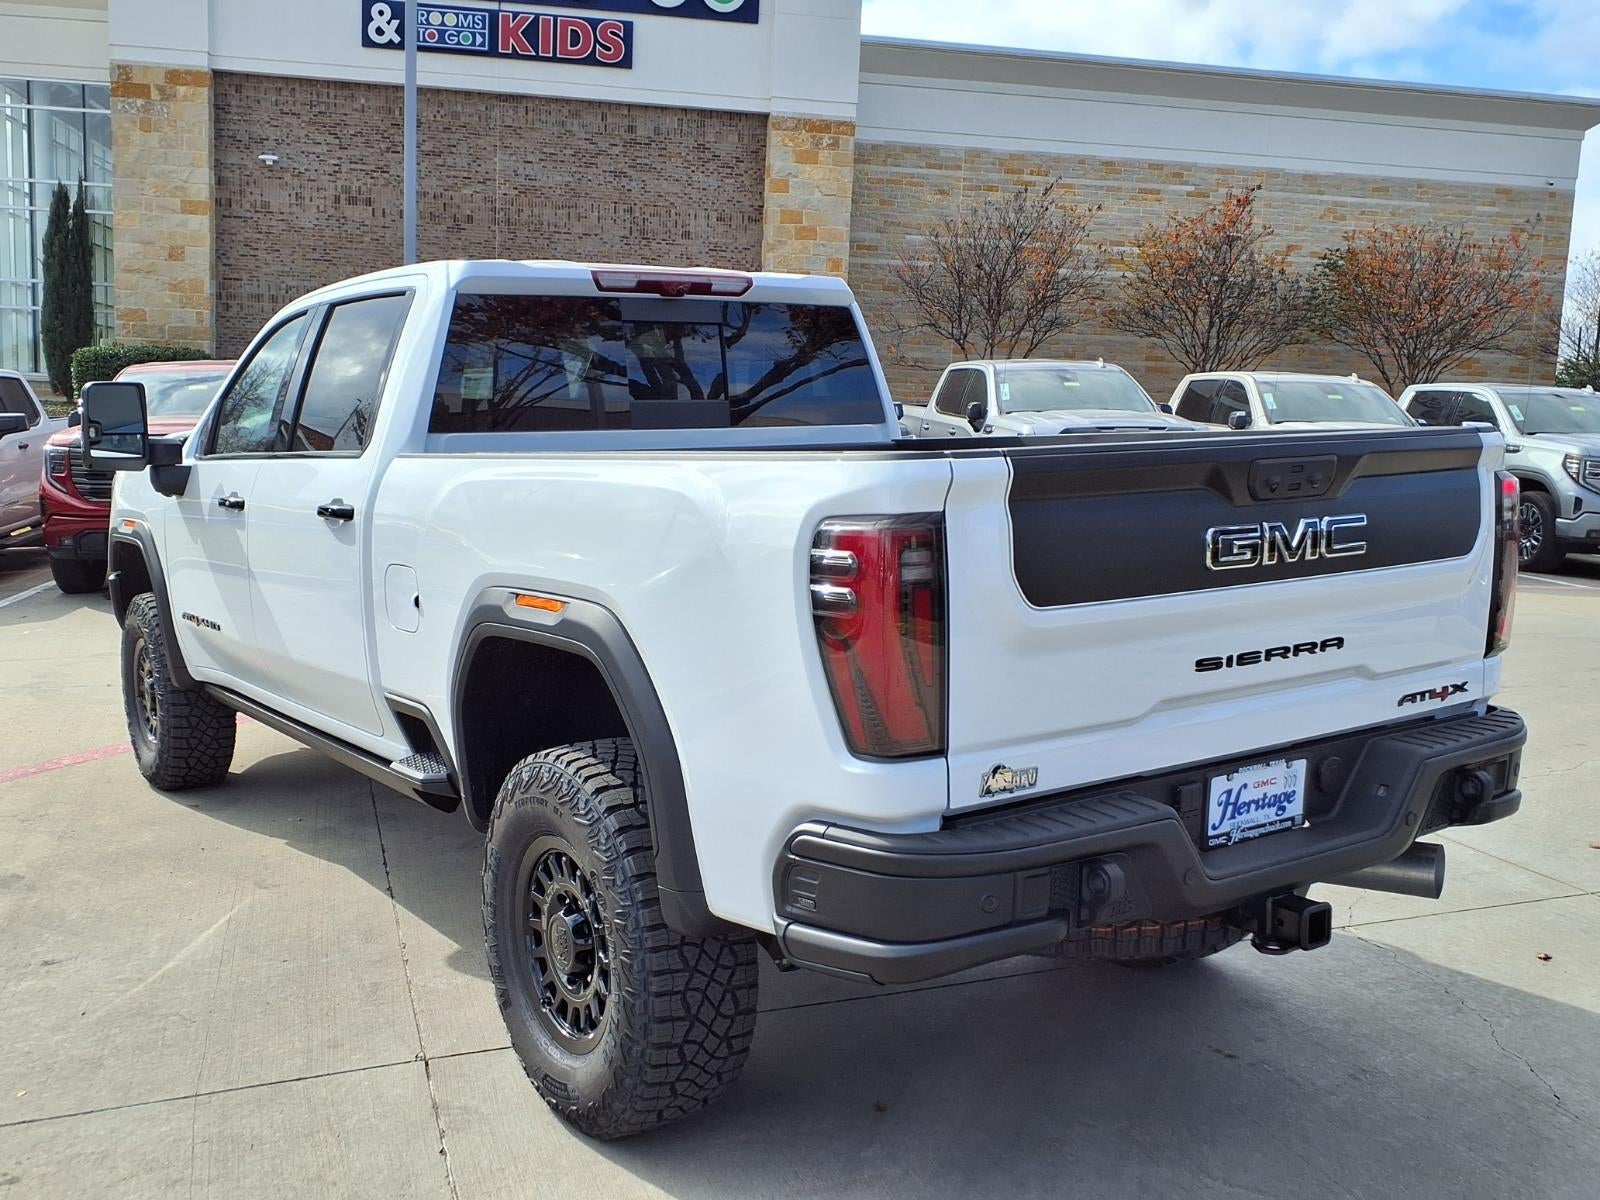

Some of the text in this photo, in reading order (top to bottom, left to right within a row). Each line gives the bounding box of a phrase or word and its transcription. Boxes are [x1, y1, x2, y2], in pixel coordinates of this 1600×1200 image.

[367, 2, 625, 63] & KIDS
[417, 11, 483, 29] ROOMS
[417, 29, 472, 45] TO GO
[1205, 513, 1368, 571] GMC
[1194, 636, 1345, 673] SIERRA
[1397, 680, 1470, 708] AT4X
[1252, 777, 1278, 790] GMC
[1210, 782, 1298, 832] Heritage
